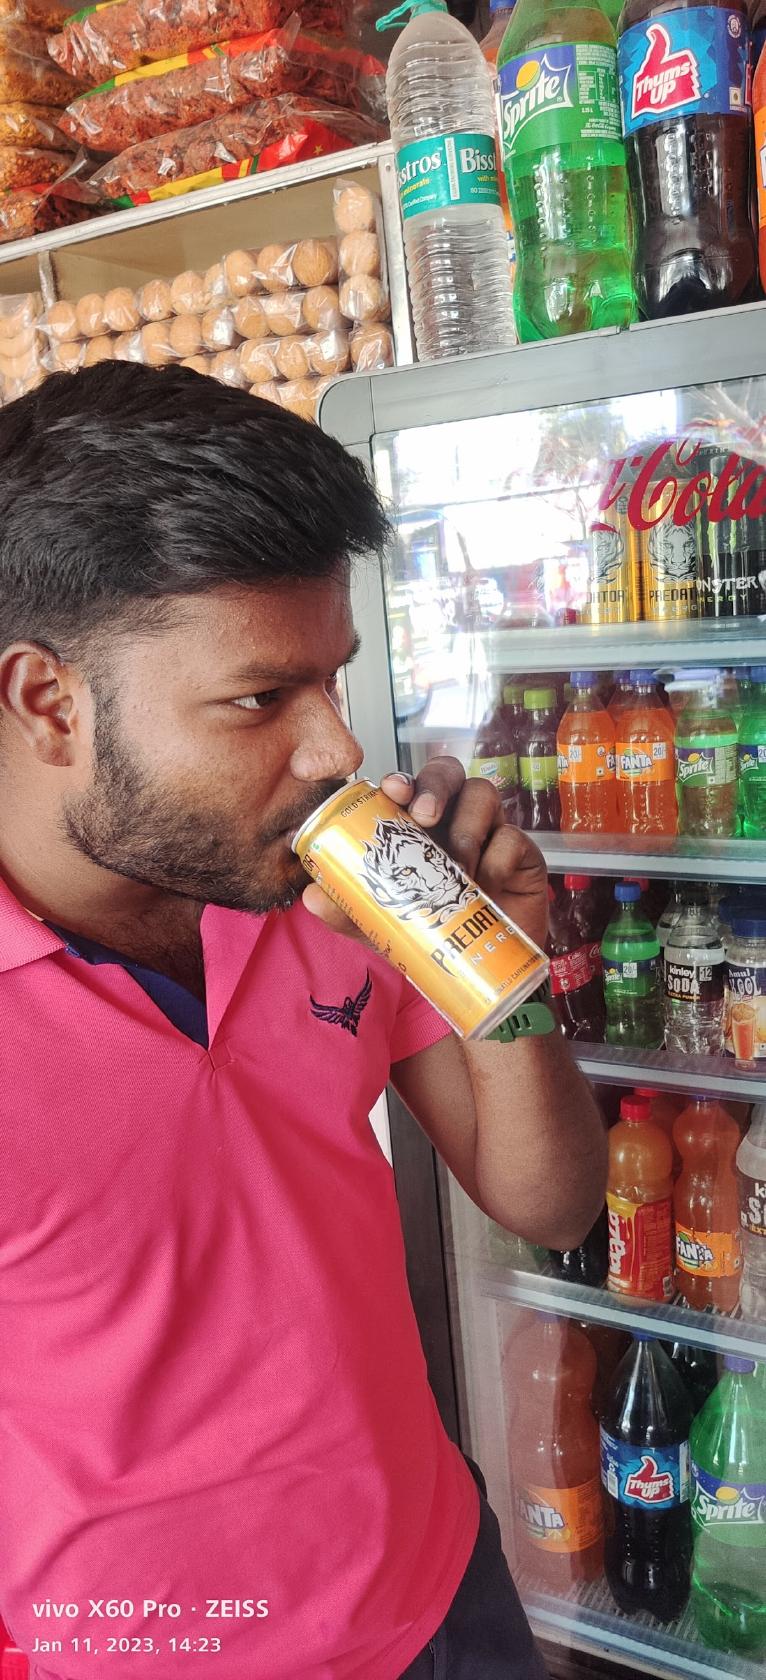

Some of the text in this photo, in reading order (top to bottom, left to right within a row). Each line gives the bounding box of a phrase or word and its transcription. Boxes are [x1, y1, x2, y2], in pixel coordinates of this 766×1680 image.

[636, 62, 690, 102] Thums
[503, 70, 560, 140] Sprite
[620, 755, 652, 769] FANTA
[679, 758, 709, 778] Sprite
[340, 802, 358, 818] GOLD
[670, 964, 695, 979] kinley
[668, 974, 700, 994] SODA
[675, 1235, 714, 1262] FANTA
[629, 1478, 670, 1491] Thums
[697, 1494, 756, 1521] Sprite
